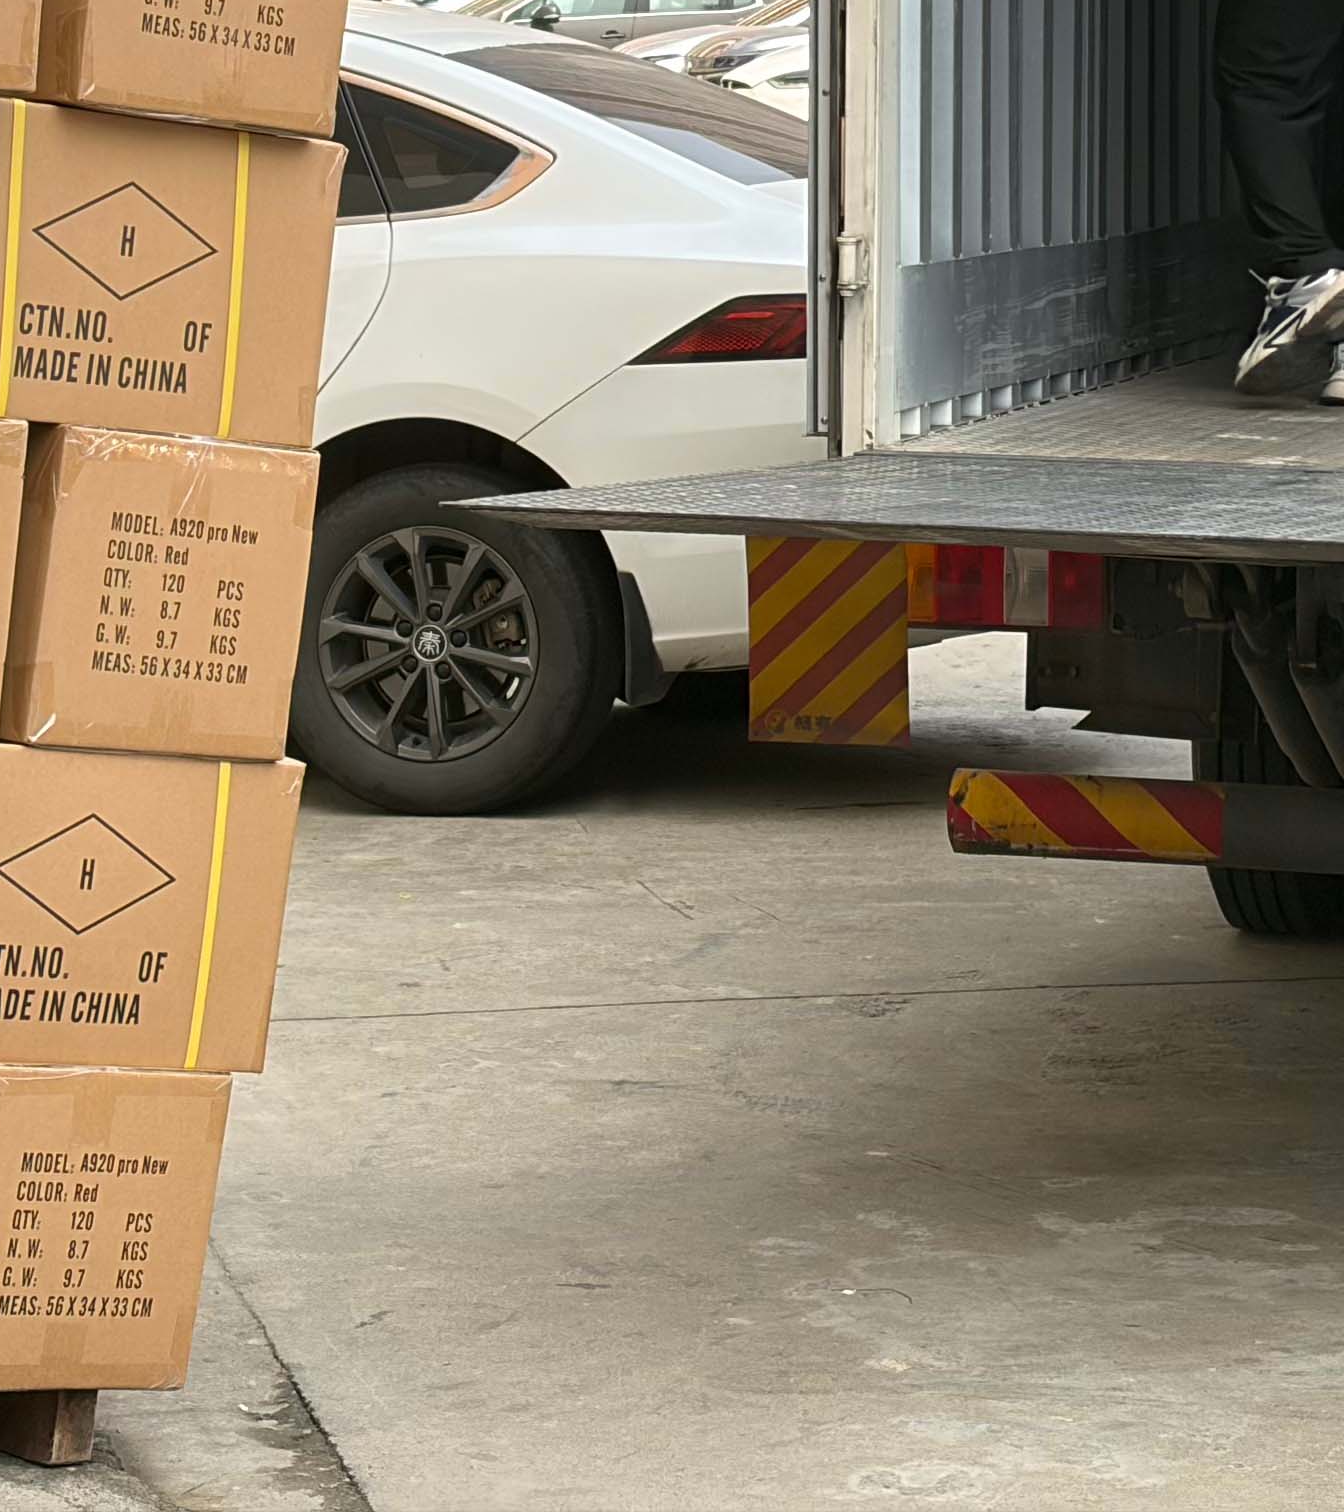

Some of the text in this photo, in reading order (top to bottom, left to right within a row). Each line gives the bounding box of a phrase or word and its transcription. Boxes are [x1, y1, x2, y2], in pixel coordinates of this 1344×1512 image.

[121, 225, 135, 257] H
[20, 303, 212, 352] CTN.NO. OF
[14, 346, 186, 393] MADE IN CHINA
[417, 630, 441, 657] 秦
[80, 859, 95, 890] H
[139, 951, 168, 983] OF
[39, 990, 66, 1021] IN
[71, 991, 140, 1024] CHINA
